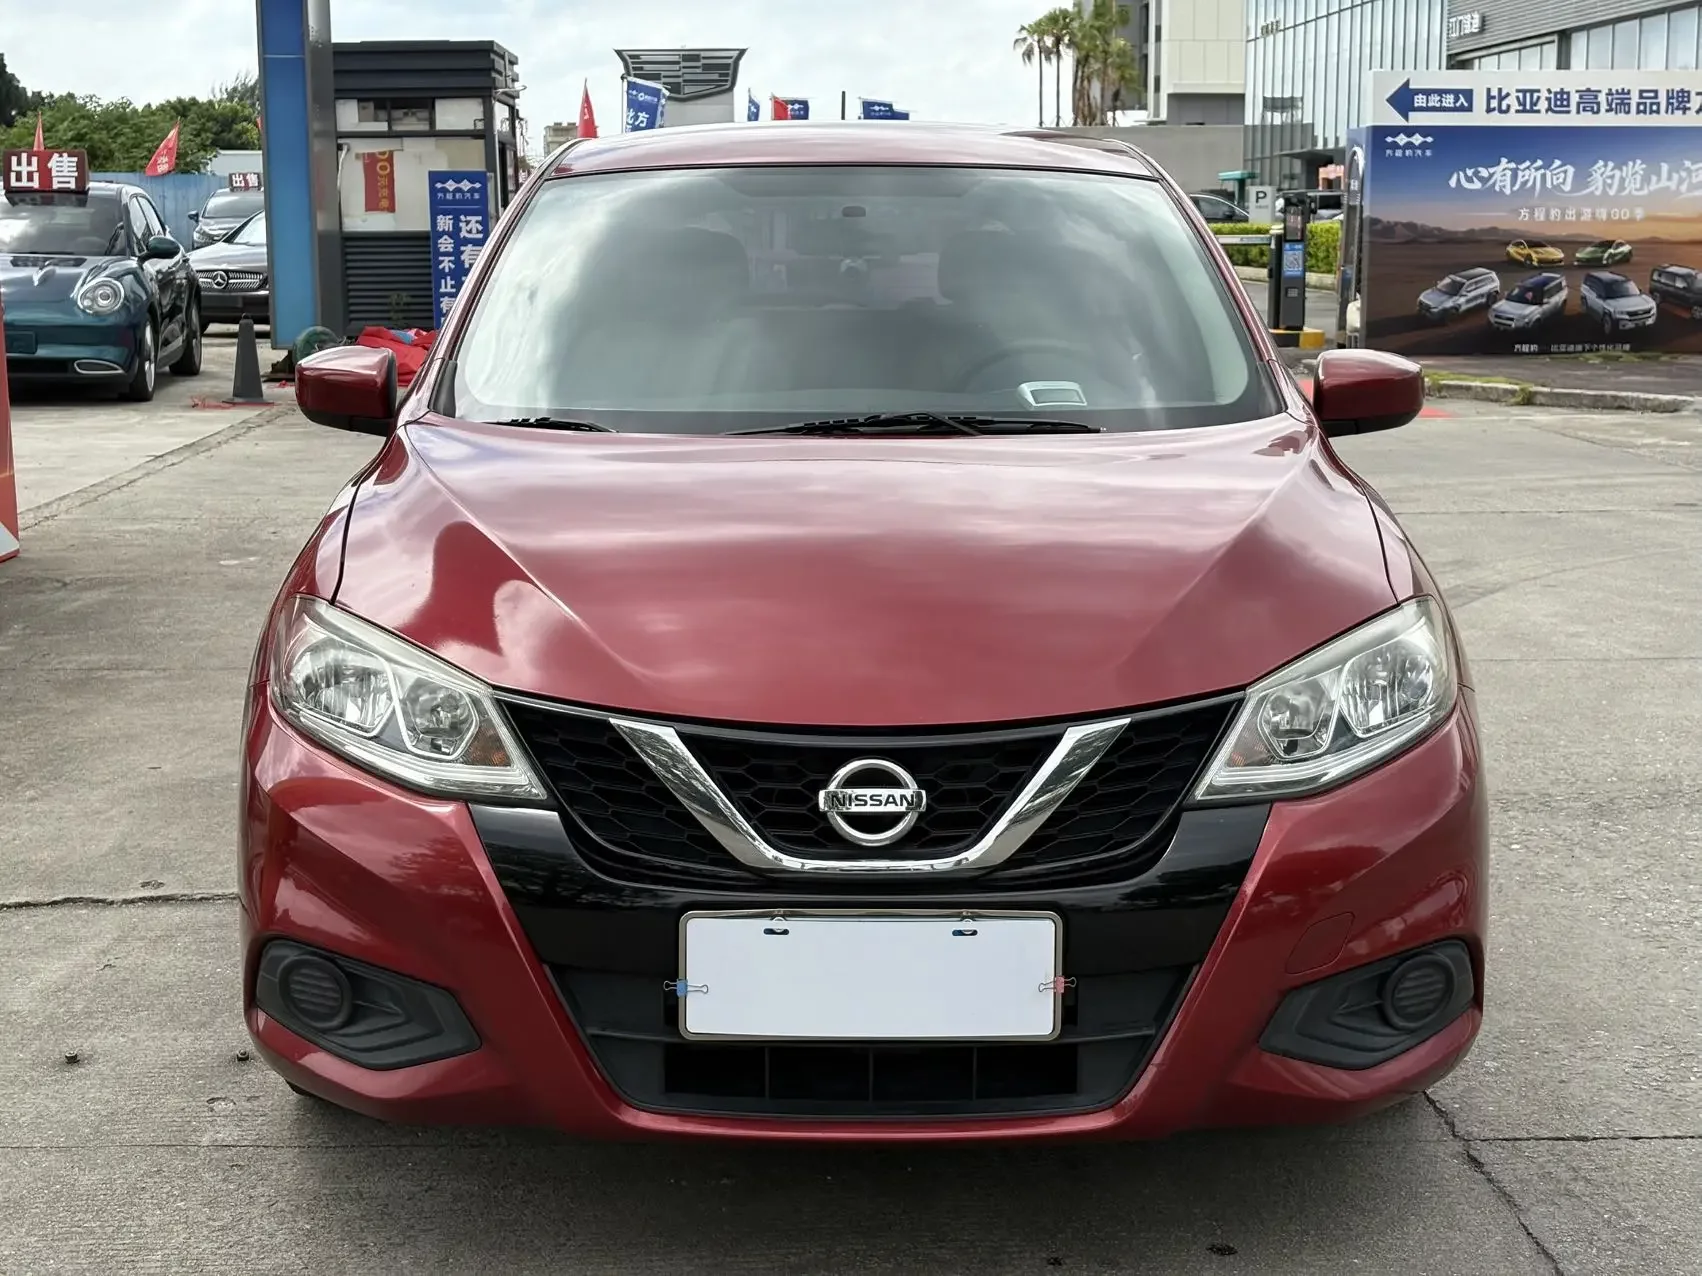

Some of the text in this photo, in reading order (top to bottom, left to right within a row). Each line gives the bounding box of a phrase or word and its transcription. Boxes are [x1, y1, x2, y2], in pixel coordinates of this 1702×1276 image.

[1413, 93, 1469, 108] 由此进入
[1485, 87, 1702, 115] 比亚迪高端品牌
[10, 152, 79, 189] 出售
[231, 173, 258, 187] 出售
[1448, 157, 1575, 198] 心有所向
[1255, 190, 1267, 204] P
[459, 215, 484, 282] 还有
[436, 215, 457, 326] 新会不止有
[831, 793, 914, 807] NISSAN
